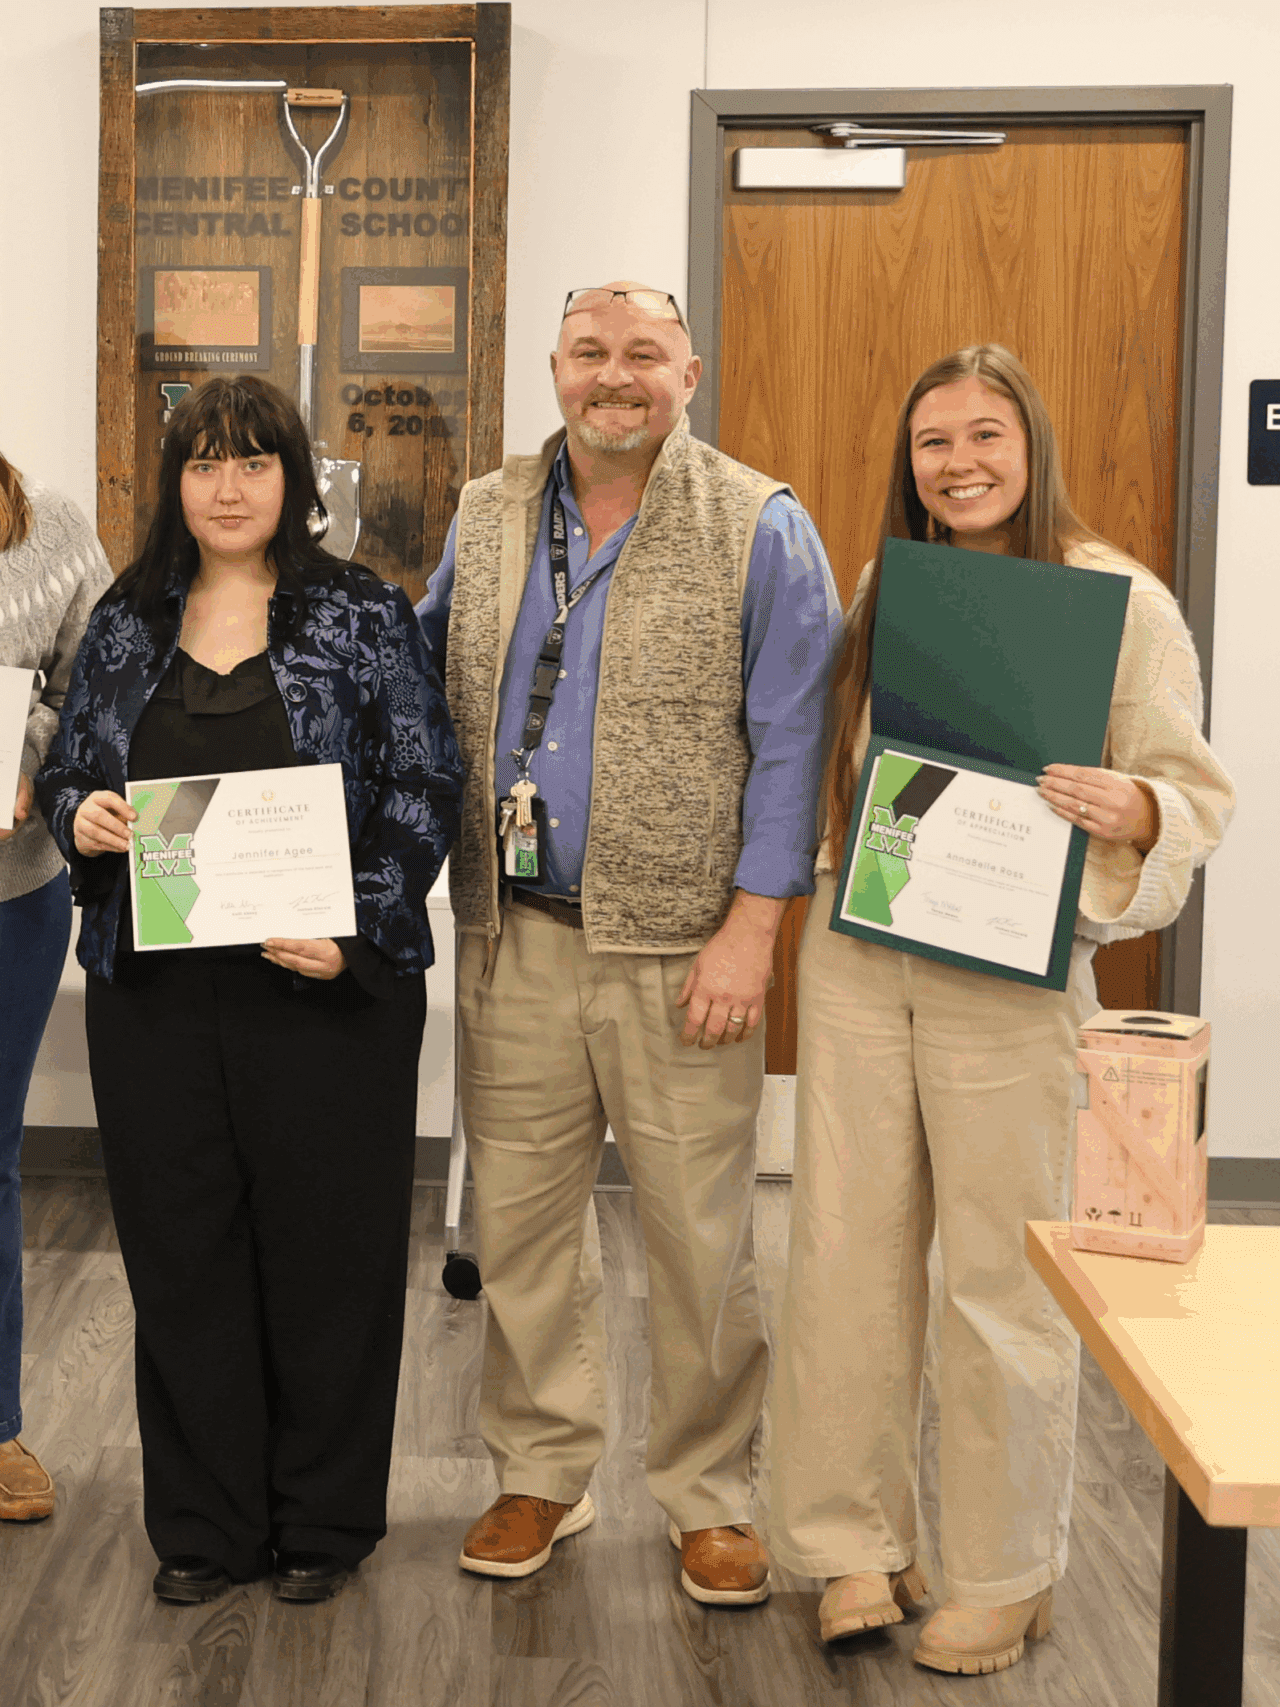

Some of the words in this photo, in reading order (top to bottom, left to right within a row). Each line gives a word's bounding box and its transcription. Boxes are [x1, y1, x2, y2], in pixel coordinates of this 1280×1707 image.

[338, 177, 470, 202] COUNT
[154, 351, 183, 362] GROUND
[184, 351, 220, 362] BREAKING
[221, 351, 258, 362] CEREMONY
[228, 804, 311, 818] CERTIFICATE
[248, 815, 305, 825] ACHIEVEMENT
[954, 807, 1032, 835] CERTIFICATE
[870, 822, 915, 843] MENIFEE
[969, 822, 1025, 842] APPRECIATION
[142, 849, 193, 862] MENIFEE
[231, 848, 280, 861] Jennifer
[284, 847, 314, 859] Agee
[946, 852, 996, 872] AnnaBelle
